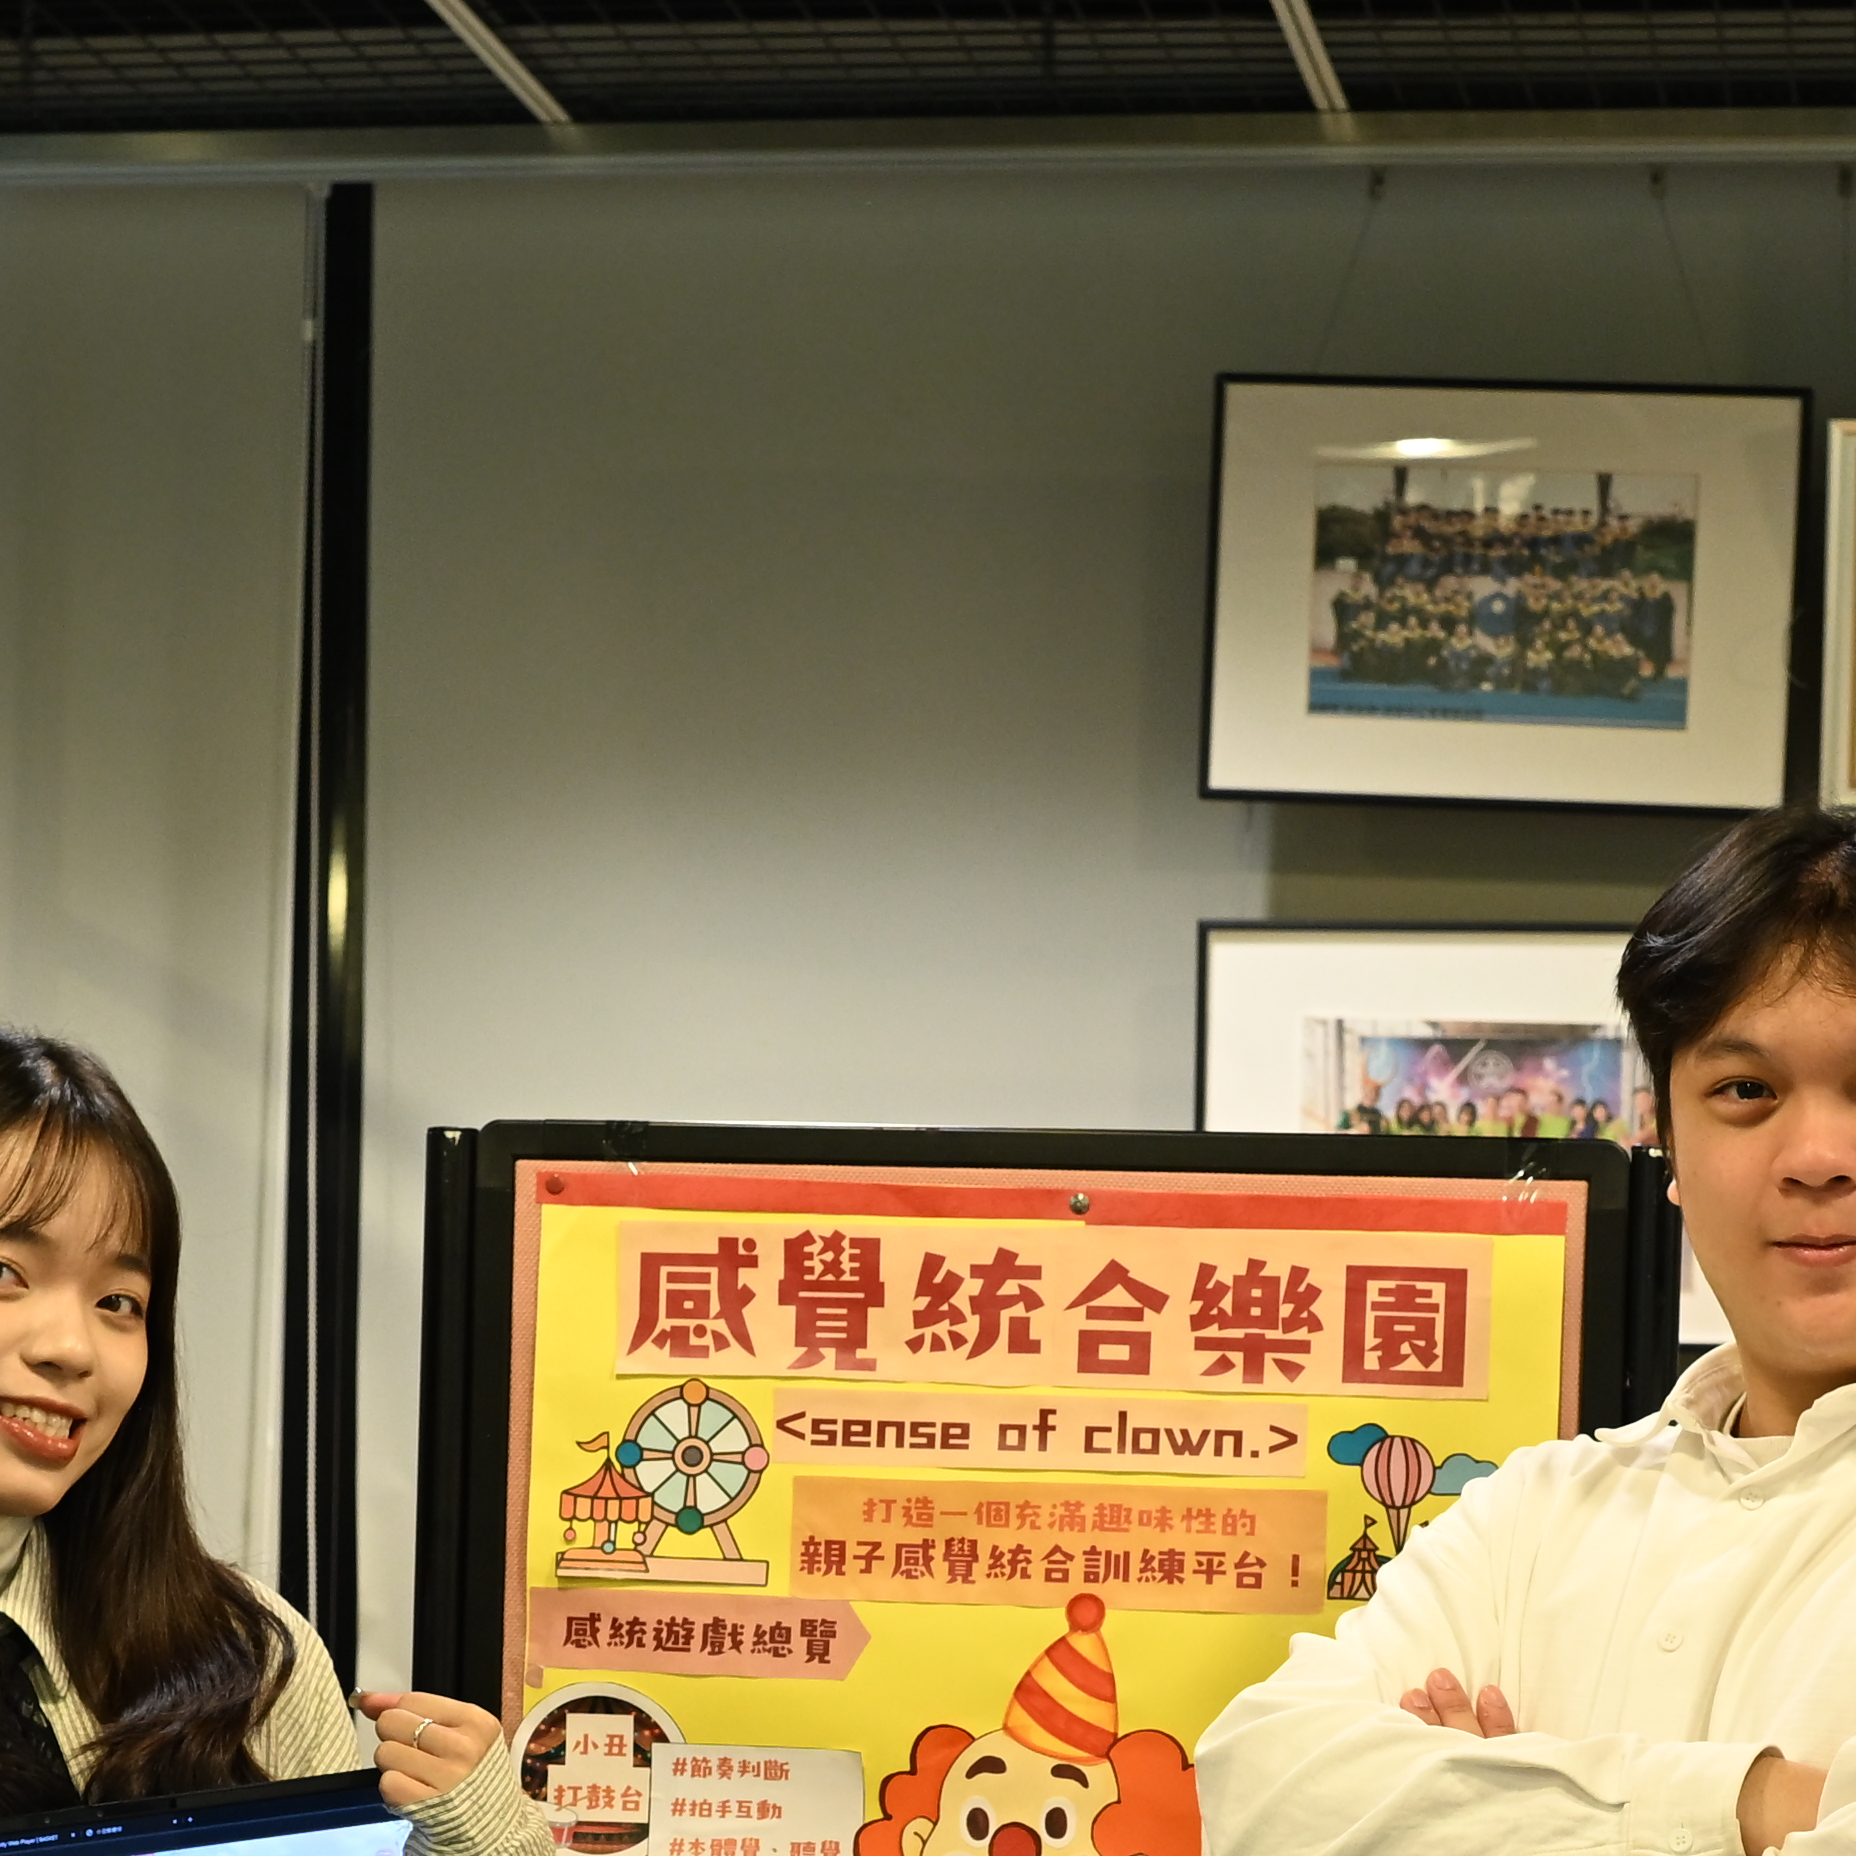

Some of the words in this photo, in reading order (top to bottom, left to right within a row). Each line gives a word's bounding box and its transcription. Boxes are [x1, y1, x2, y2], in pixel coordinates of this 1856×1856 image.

[626, 1229, 1469, 1388] 感覺統合樂園
[775, 1410, 971, 1450] <sense
[997, 1408, 1057, 1453] of
[1083, 1409, 1299, 1459] clown.>
[862, 1495, 1257, 1537] 打造一個充滿趣味性的
[562, 1611, 838, 1665] 感統遊戲總覽
[572, 1733, 628, 1758] 小丑
[671, 1756, 791, 1782] #節奏判斷
[553, 1783, 644, 1813] 打鼓台
[670, 1797, 784, 1821] #拍手互動
